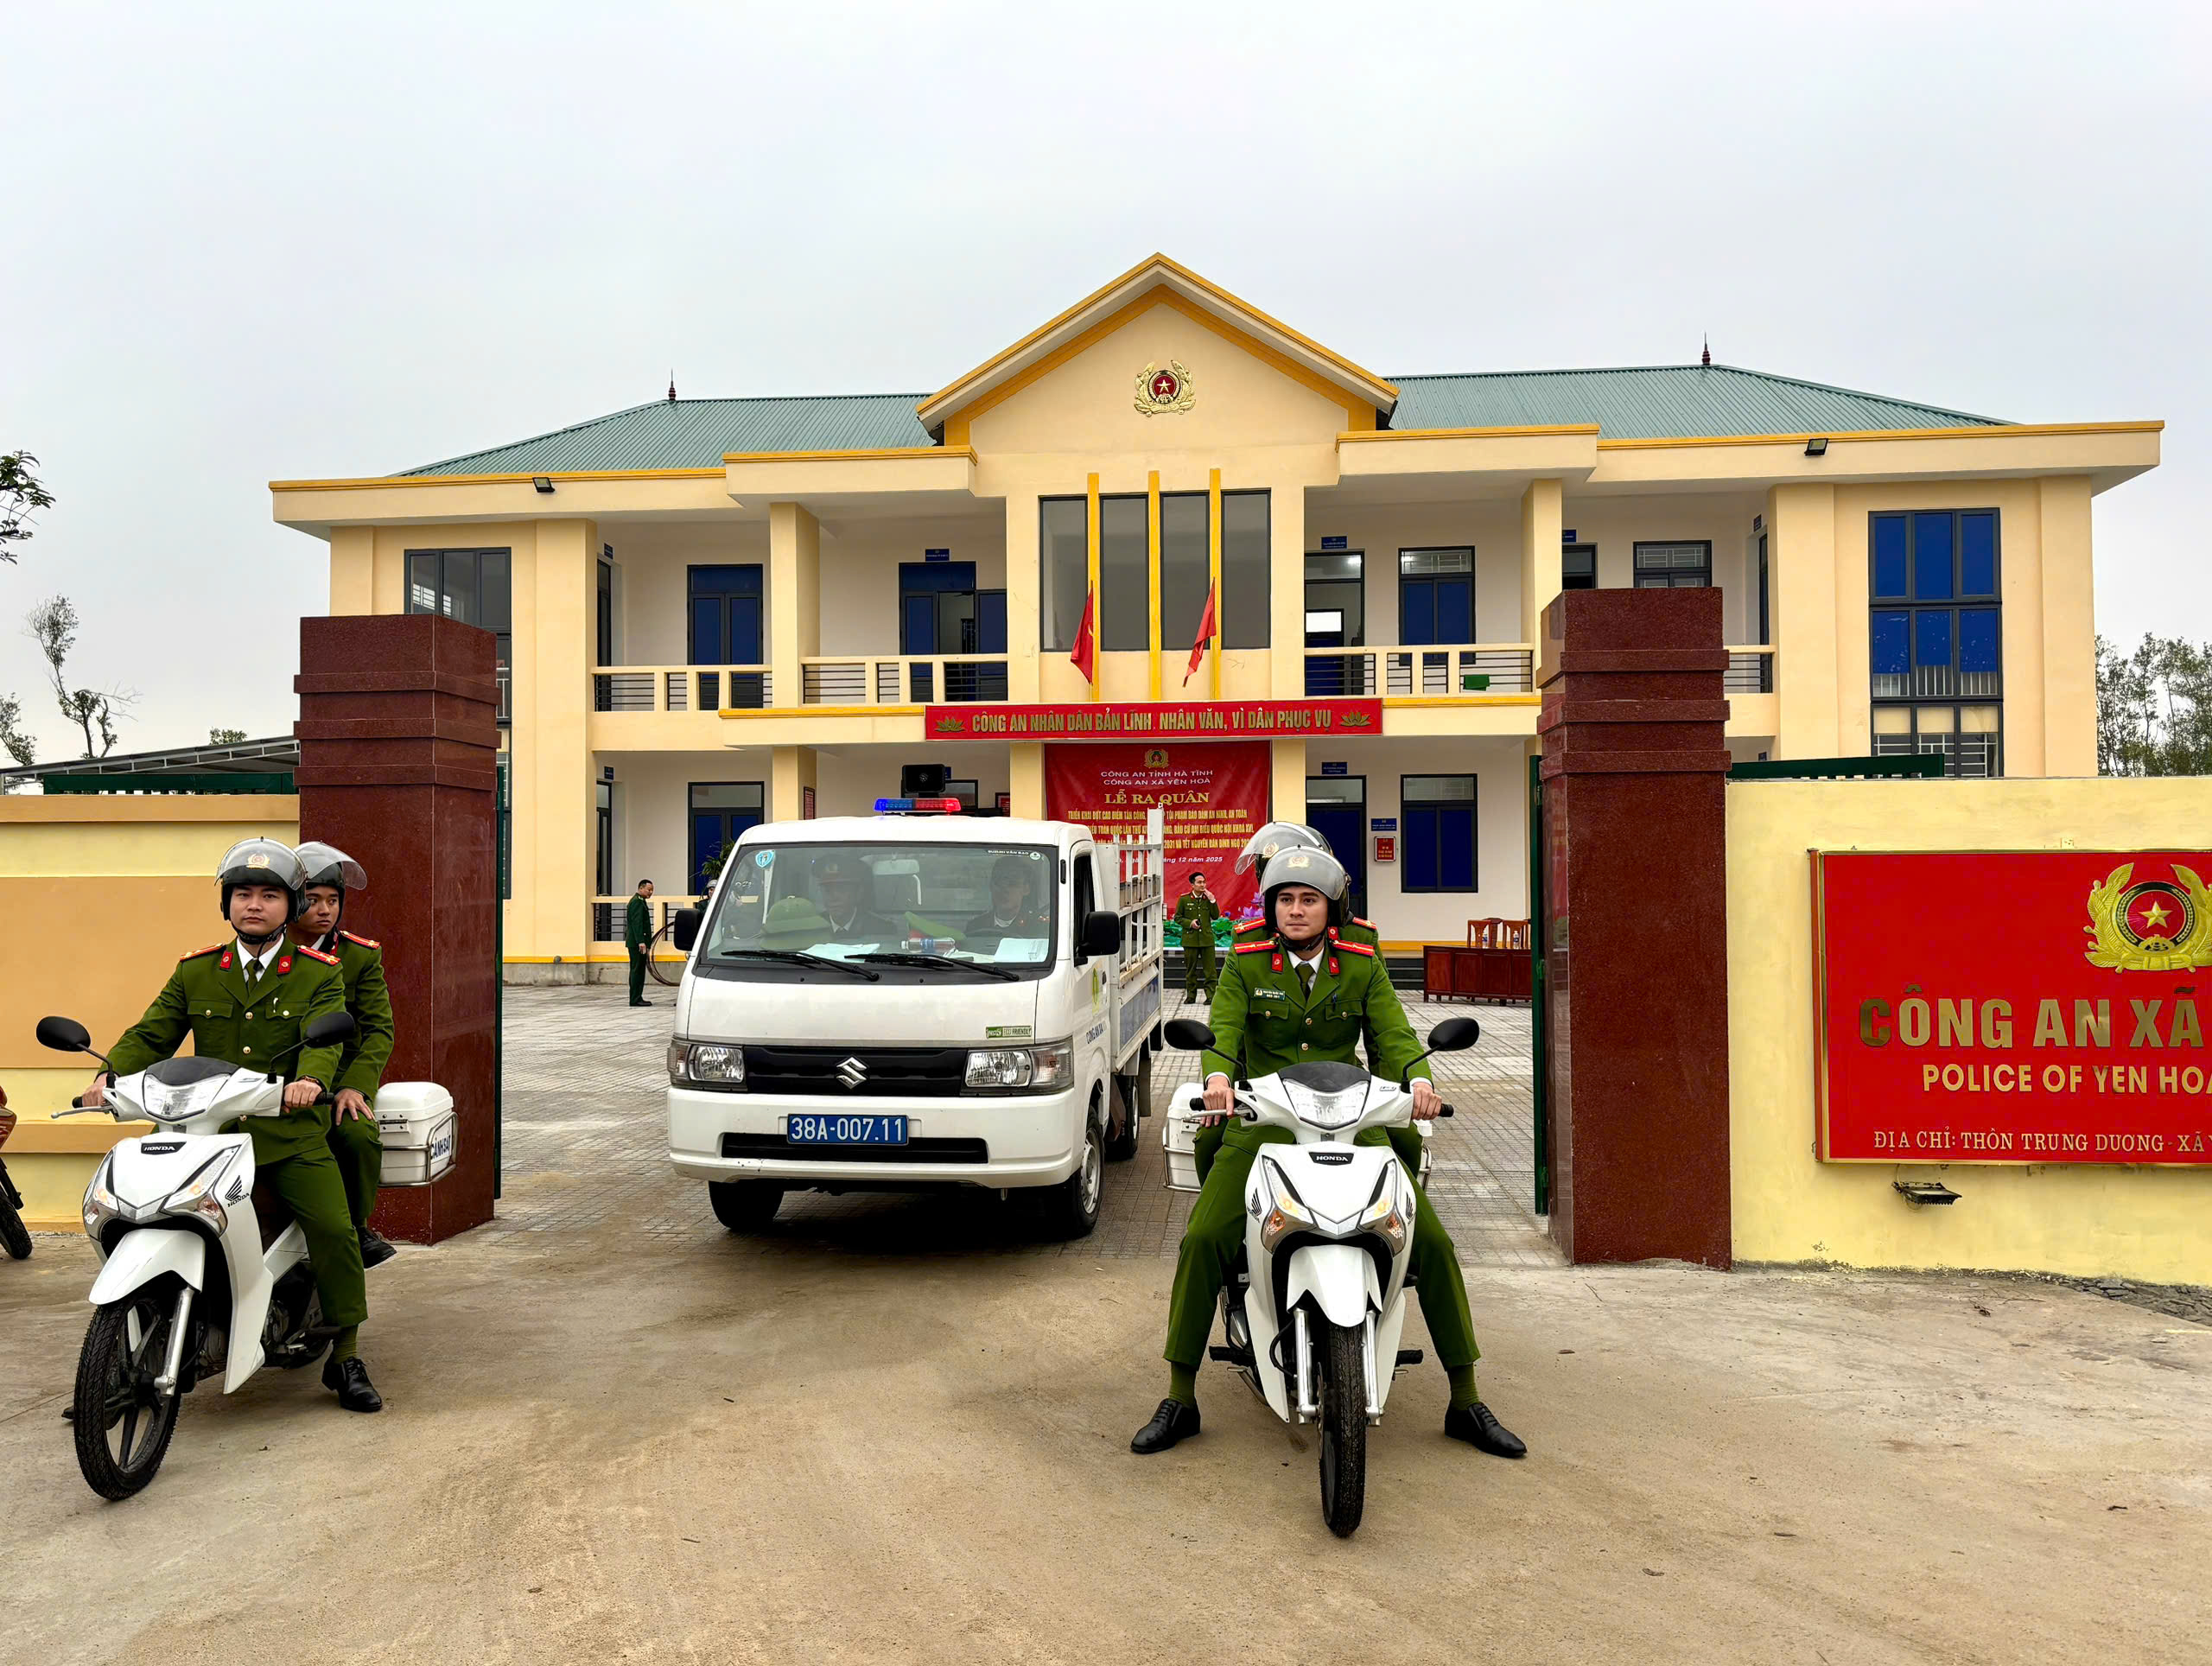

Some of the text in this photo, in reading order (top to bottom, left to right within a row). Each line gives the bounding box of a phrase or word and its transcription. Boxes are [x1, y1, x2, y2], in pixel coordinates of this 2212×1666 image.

[972, 711, 1007, 733] CÔNG
[1009, 714, 1027, 732] AN
[1030, 710, 1065, 732] NHÂN
[1067, 710, 1093, 731] DÂN
[1096, 708, 1121, 731] BẢN
[1160, 709, 1195, 730] NHÂN
[1198, 709, 1227, 731] VĂN,
[1232, 708, 1245, 729] VÌ
[1248, 708, 1274, 728] DÂN
[1277, 709, 1311, 732] PHỤC
[1314, 709, 1331, 732] VỤ
[1104, 788, 1210, 805] LỄ RA QUÂN
[1859, 983, 2205, 1049] CÔNG AN XÃ
[1923, 1063, 2212, 1094] POLICE OF YEN HO
[791, 1116, 903, 1141] 38A-007.11
[1874, 1130, 1910, 1153] ĐỊA
[1916, 1126, 1956, 1148] CHỈ:
[1961, 1128, 2013, 1150] THÔN
[2021, 1133, 2088, 1151] TRUNG
[2094, 1134, 2164, 1152] DƯƠNG
[2177, 1130, 2205, 1152] XÃ
[227, 1192, 250, 1208] HONDA
